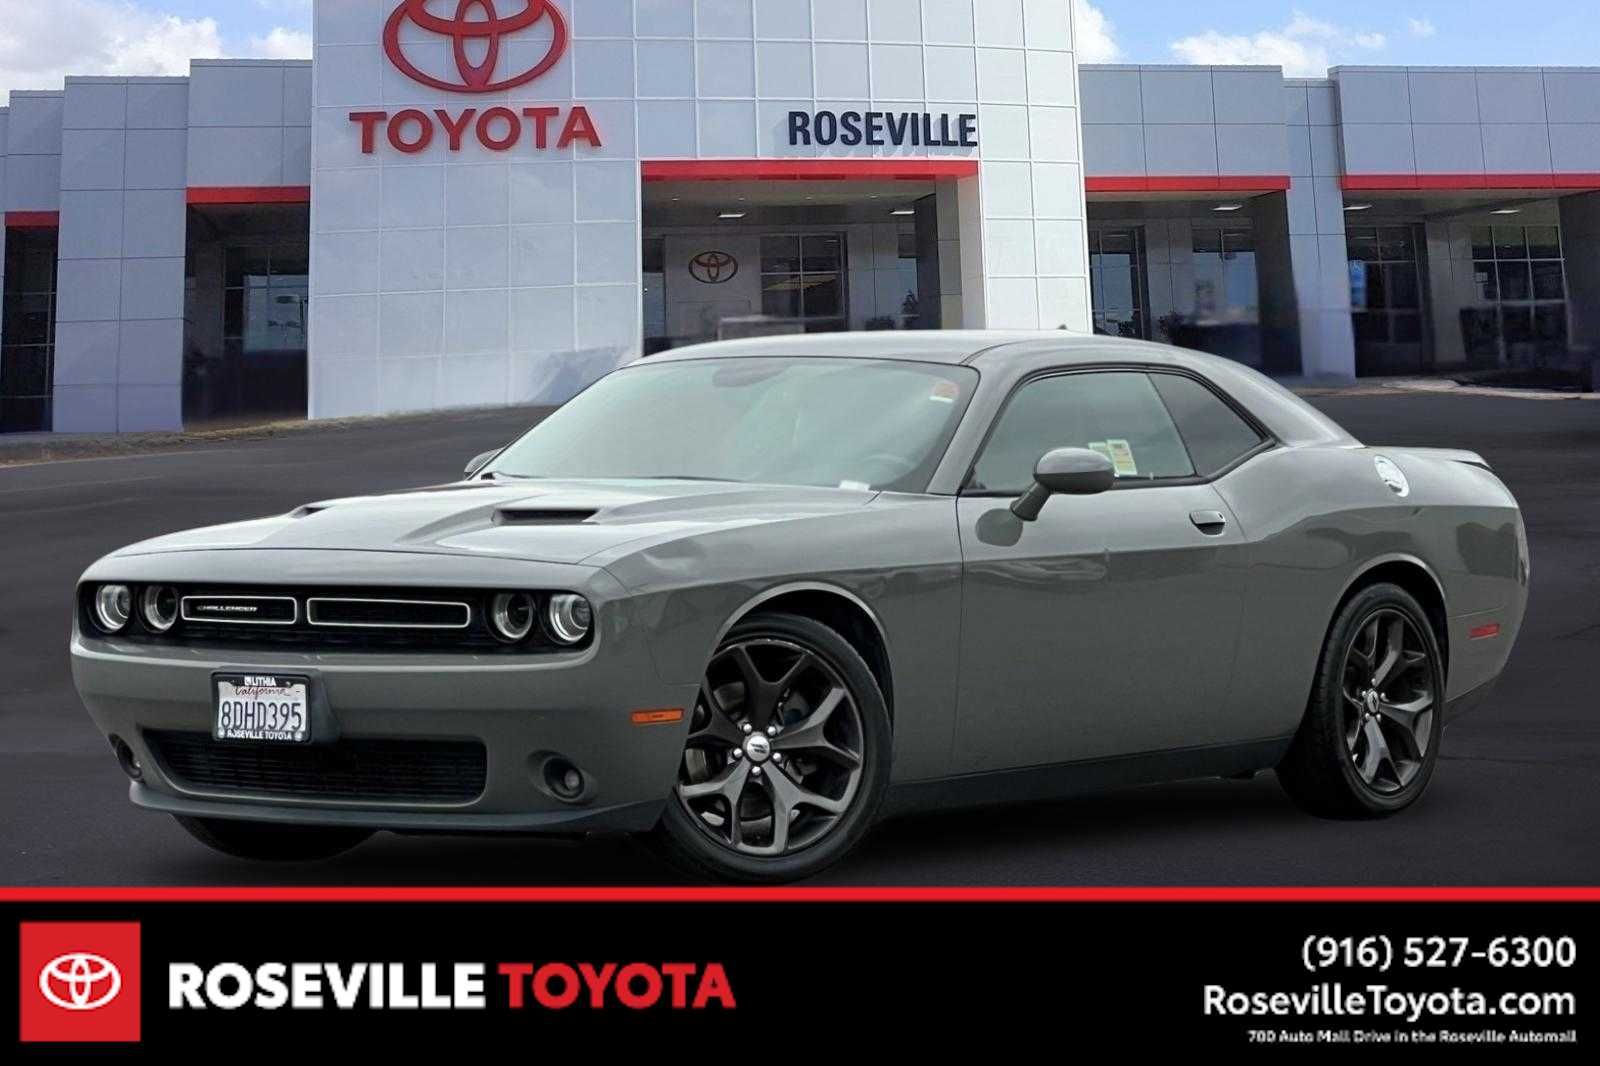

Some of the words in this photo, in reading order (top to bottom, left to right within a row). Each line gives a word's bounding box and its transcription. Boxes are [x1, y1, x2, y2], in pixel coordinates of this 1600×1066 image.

[349, 105, 602, 154] TOYOTA
[788, 110, 979, 147] ROSEVILLE
[221, 701, 302, 731] 8DHD395
[226, 730, 264, 740] ROSEVILLE
[264, 731, 292, 741] TOYOTA
